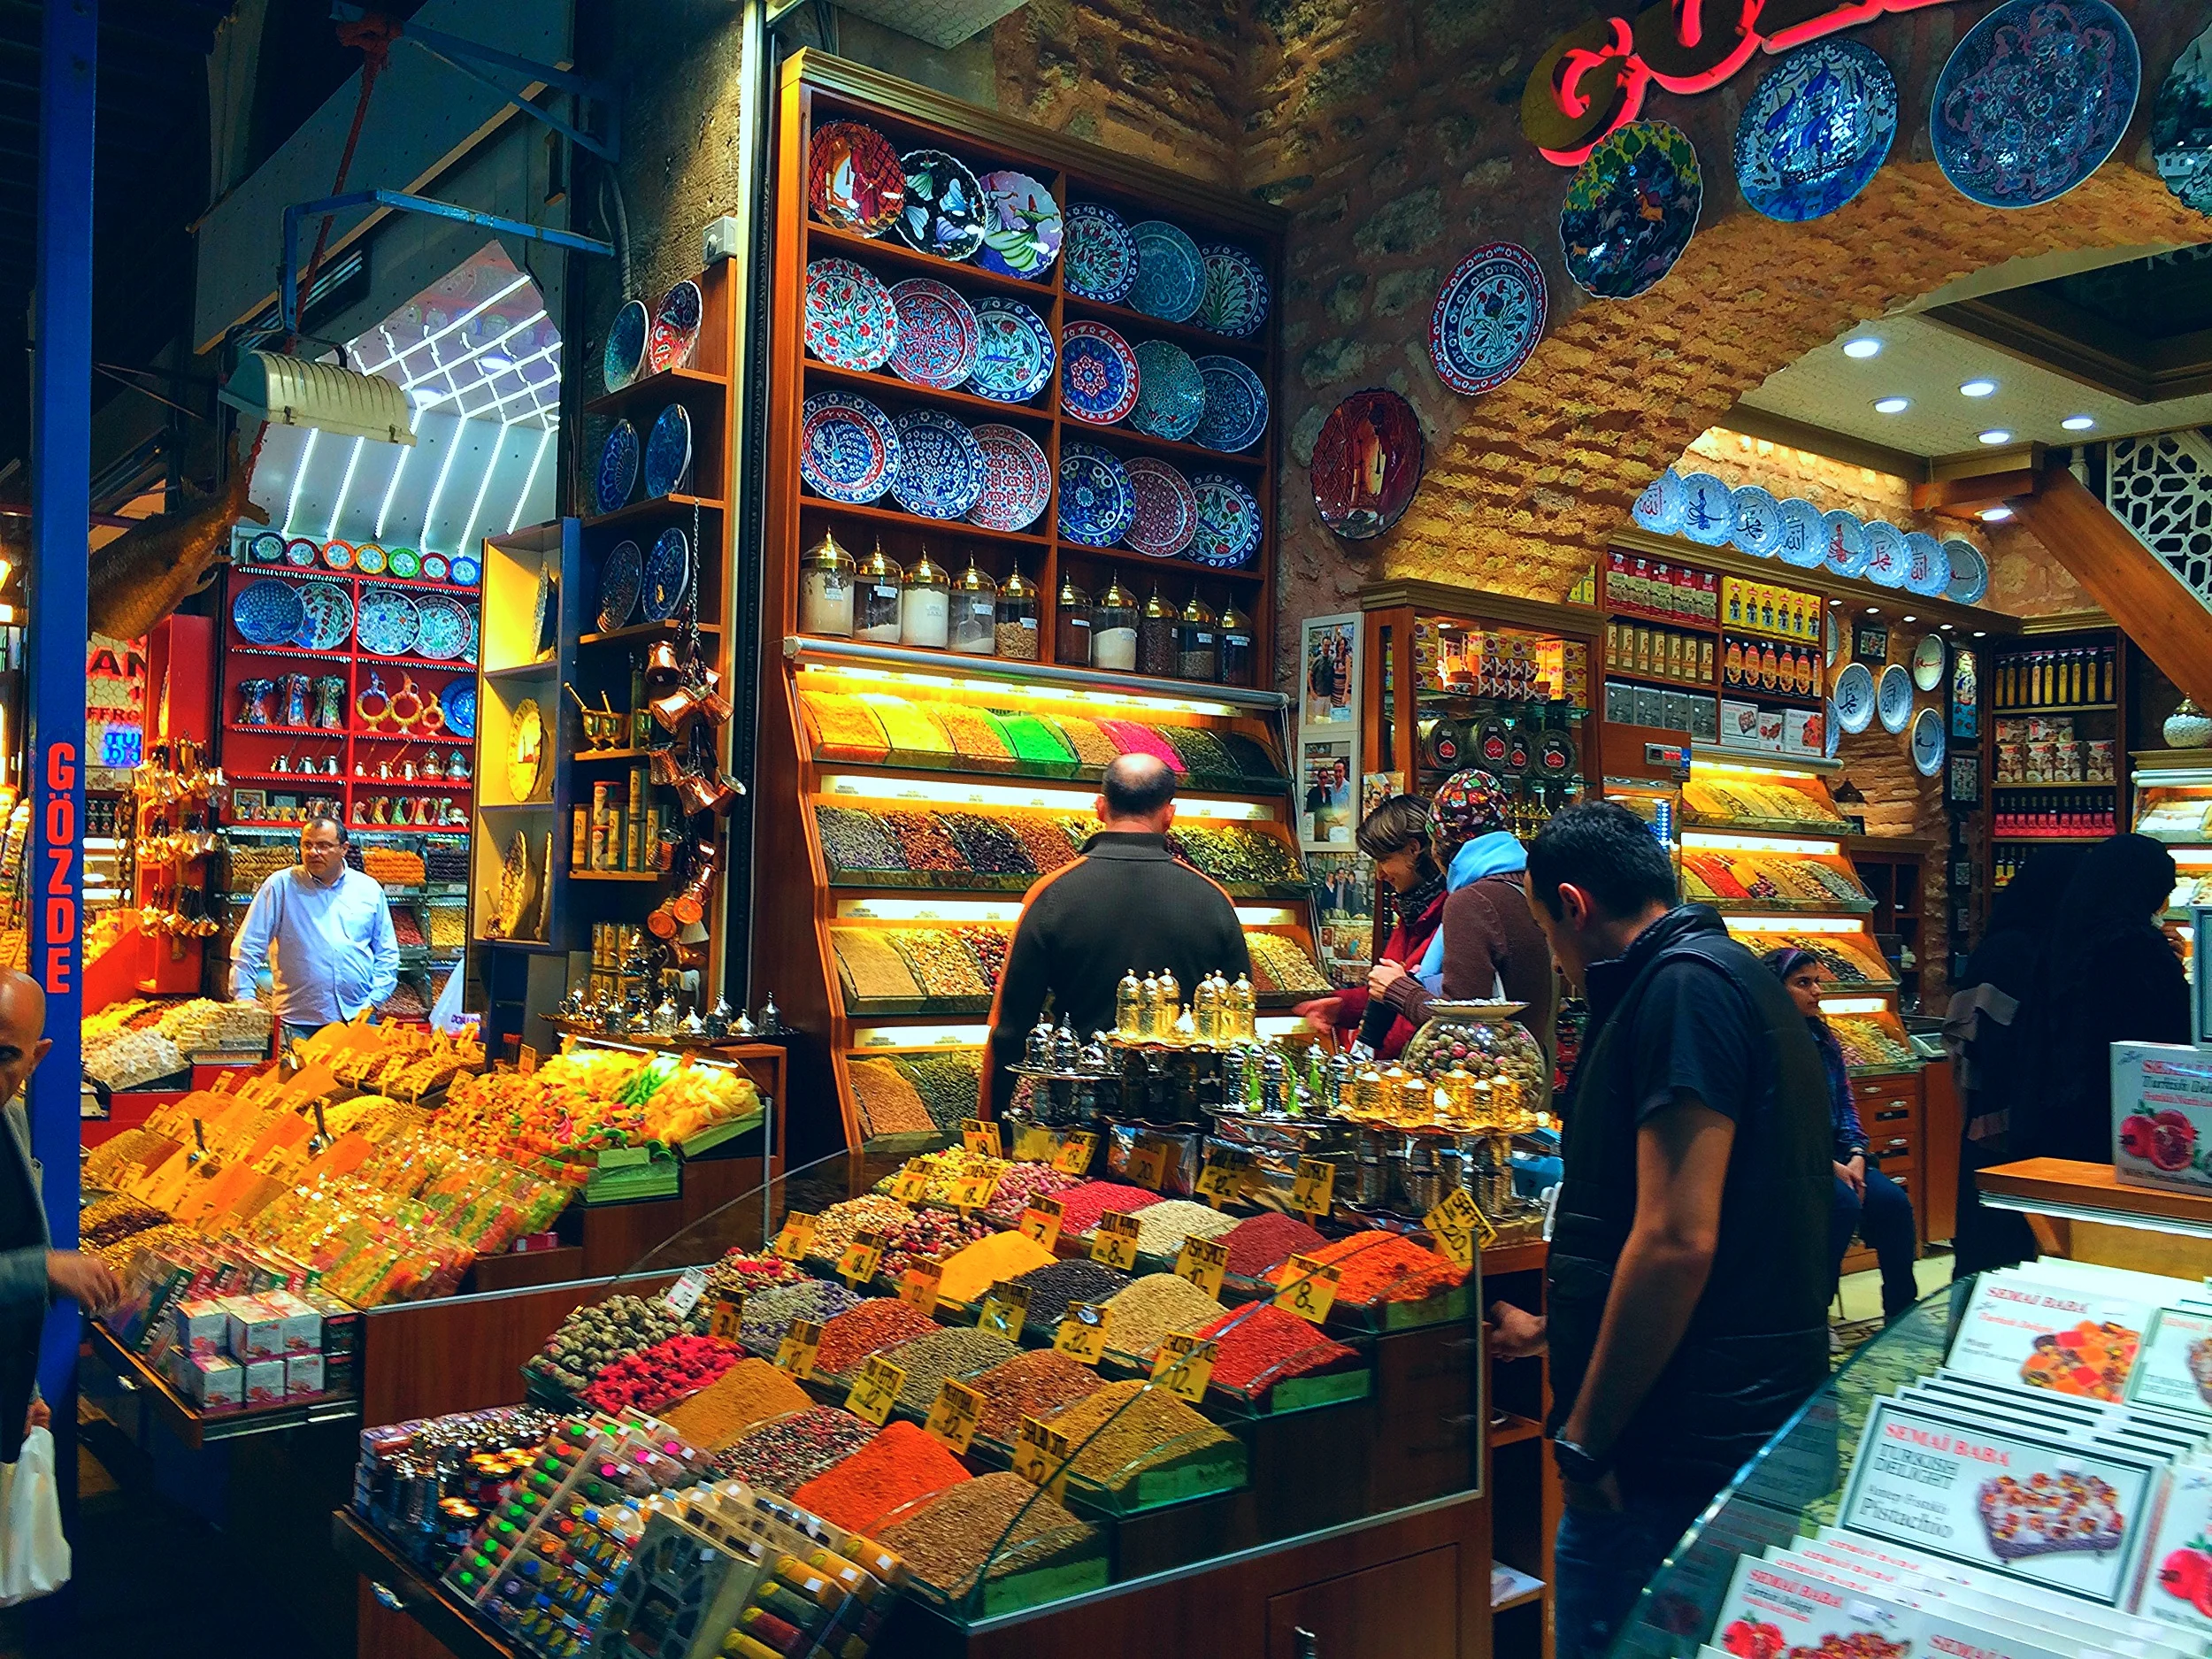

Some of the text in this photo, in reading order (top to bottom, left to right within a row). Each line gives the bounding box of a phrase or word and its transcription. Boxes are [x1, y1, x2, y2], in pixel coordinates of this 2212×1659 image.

[46, 741, 75, 994] GÖZDE
[1441, 1224, 1469, 1251] 20
[1295, 1281, 1311, 1309] 8
[1879, 1442, 1960, 1476] TURKISH
[1953, 1439, 2010, 1468] BABA
[1859, 1496, 1955, 1540] Pistachio
